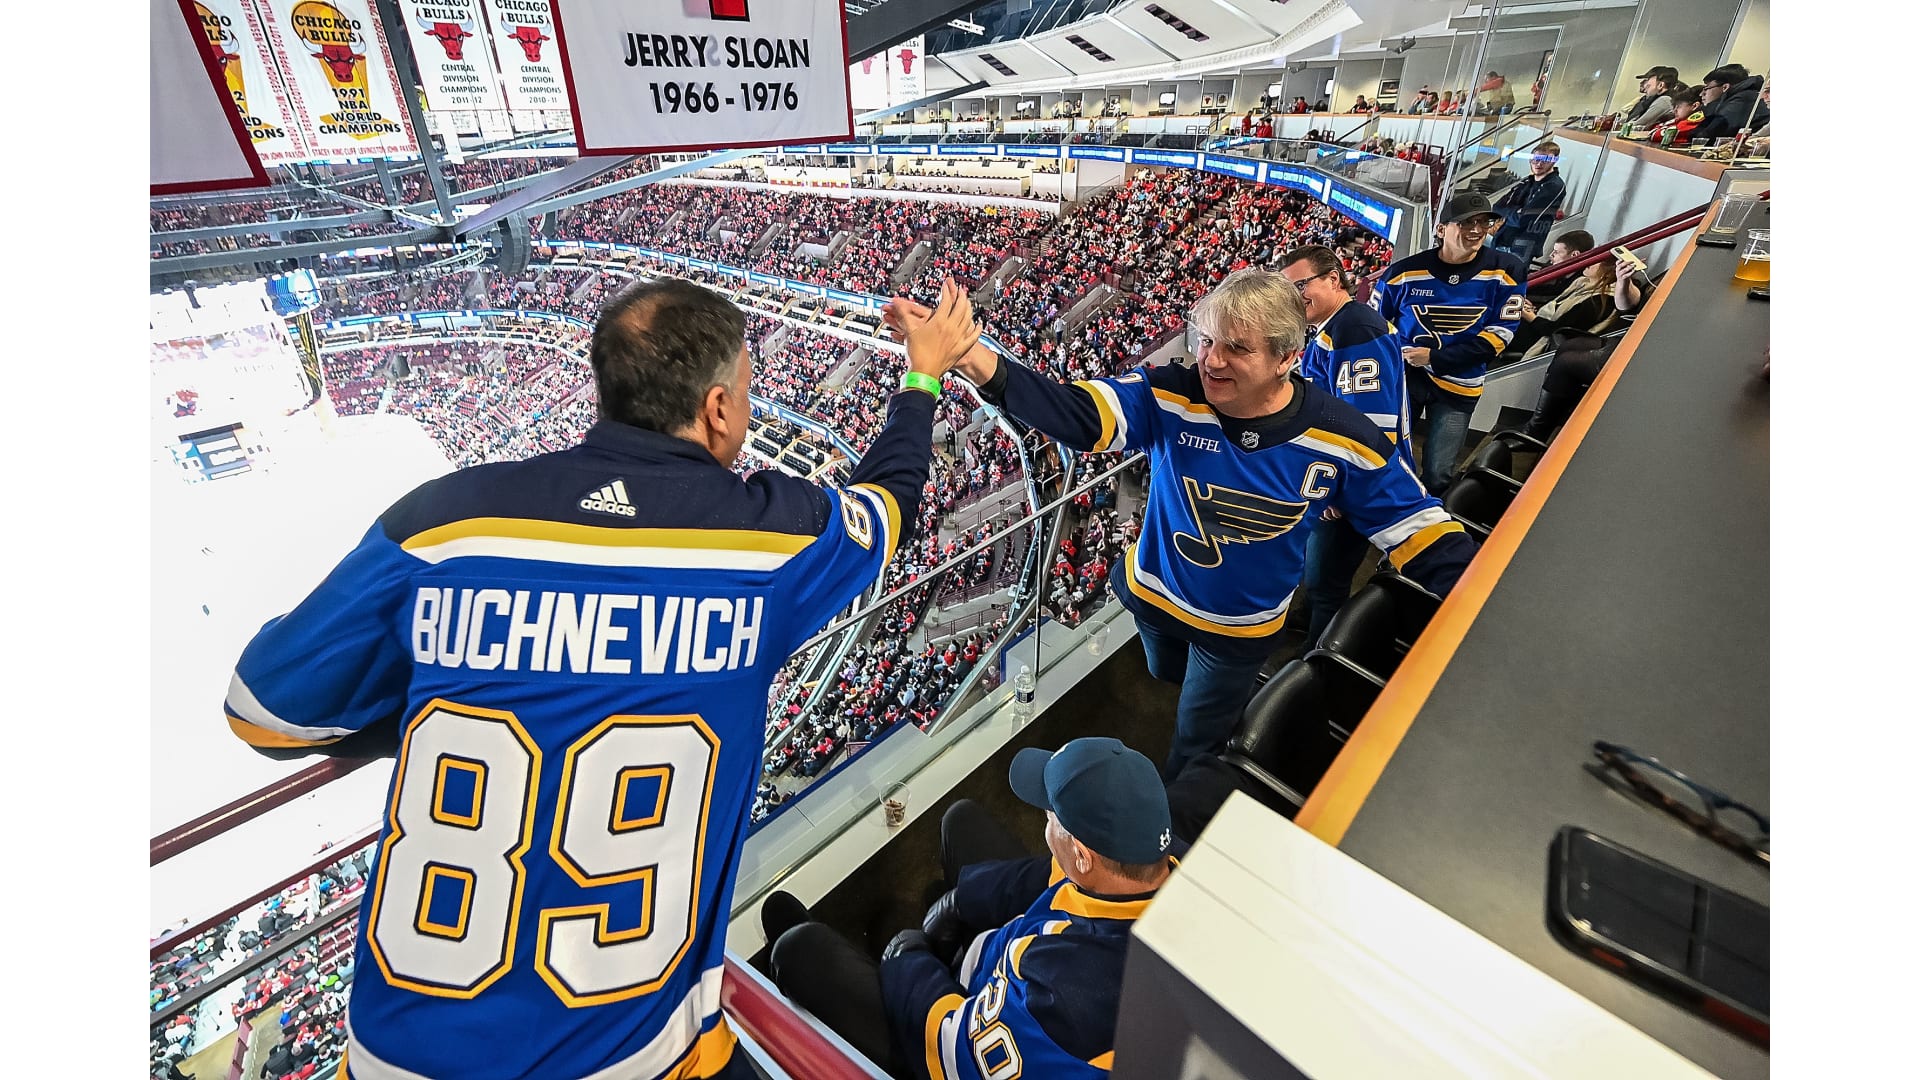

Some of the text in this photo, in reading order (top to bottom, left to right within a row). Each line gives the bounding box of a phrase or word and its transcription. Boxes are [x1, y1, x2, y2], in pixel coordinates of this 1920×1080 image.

[496, 0, 549, 12] CHICAGO
[422, 8, 465, 20] BULLS
[507, 12, 545, 24] BULLS
[295, 15, 361, 30] CHICAGO
[309, 30, 357, 43] BULLS
[624, 32, 810, 69] JERRY SLOAN
[441, 63, 475, 72] CENTRAL
[521, 65, 551, 73] CENTRAL
[443, 74, 480, 83] DIVISION
[522, 76, 555, 84] DIVISION
[332, 88, 365, 98] 1991
[439, 85, 488, 94] CHAMPIONS
[519, 86, 562, 94] CHAMPIONS
[649, 81, 719, 113] 1966
[741, 82, 798, 112] 1976
[339, 100, 368, 110] NBA
[331, 112, 382, 122] WORLD
[319, 124, 401, 135] CHAMPIONS
[1410, 287, 1435, 297] STIFEL
[1336, 358, 1381, 395] 42
[1177, 431, 1221, 453] STIFEL
[1300, 461, 1338, 500] C
[580, 498, 638, 517] adidas
[411, 586, 765, 674] BUCHNEVICH
[367, 698, 722, 1009] 89
[969, 977, 1023, 1080] 20
